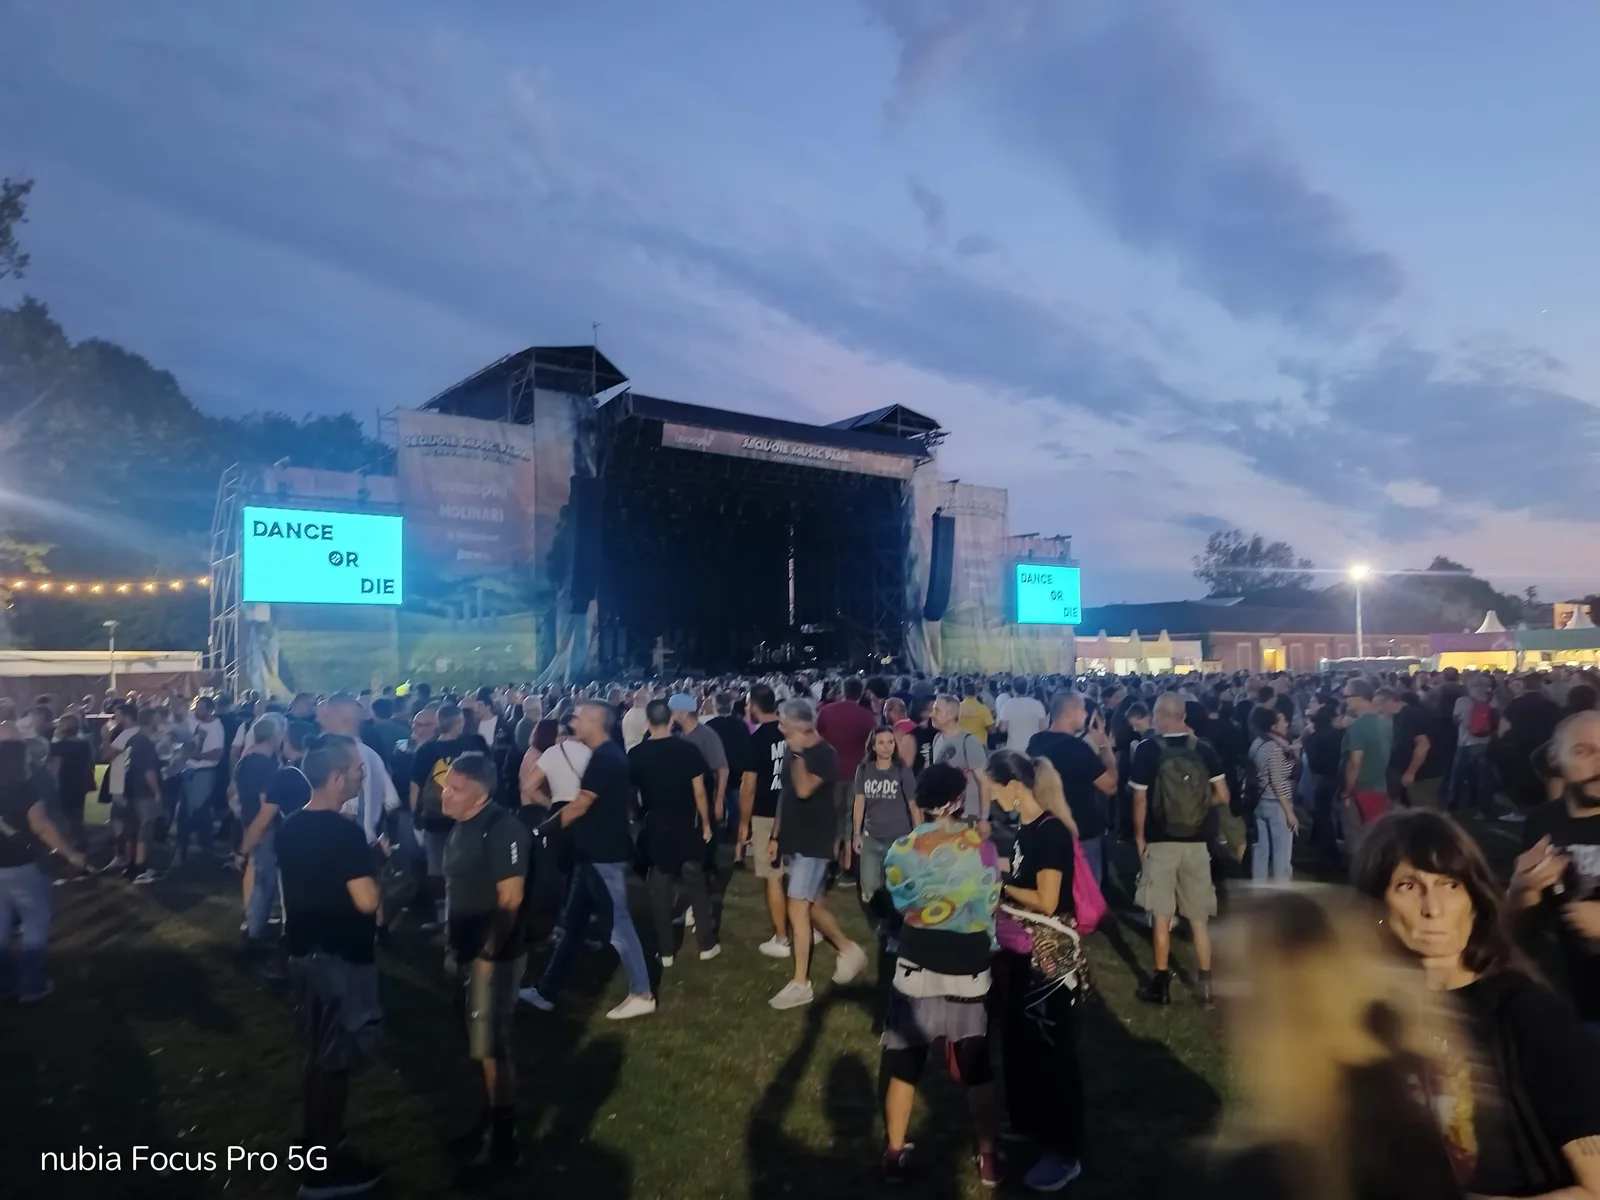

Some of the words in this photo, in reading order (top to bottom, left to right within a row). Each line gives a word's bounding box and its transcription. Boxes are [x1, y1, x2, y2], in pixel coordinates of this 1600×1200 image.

[253, 520, 334, 541] DANCE
[328, 550, 359, 568] OR
[360, 578, 395, 595] DIE
[1020, 572, 1053, 585] DANCE
[1050, 590, 1064, 601] OR
[1063, 607, 1079, 618] DIE
[864, 778, 900, 796] AC/DC
